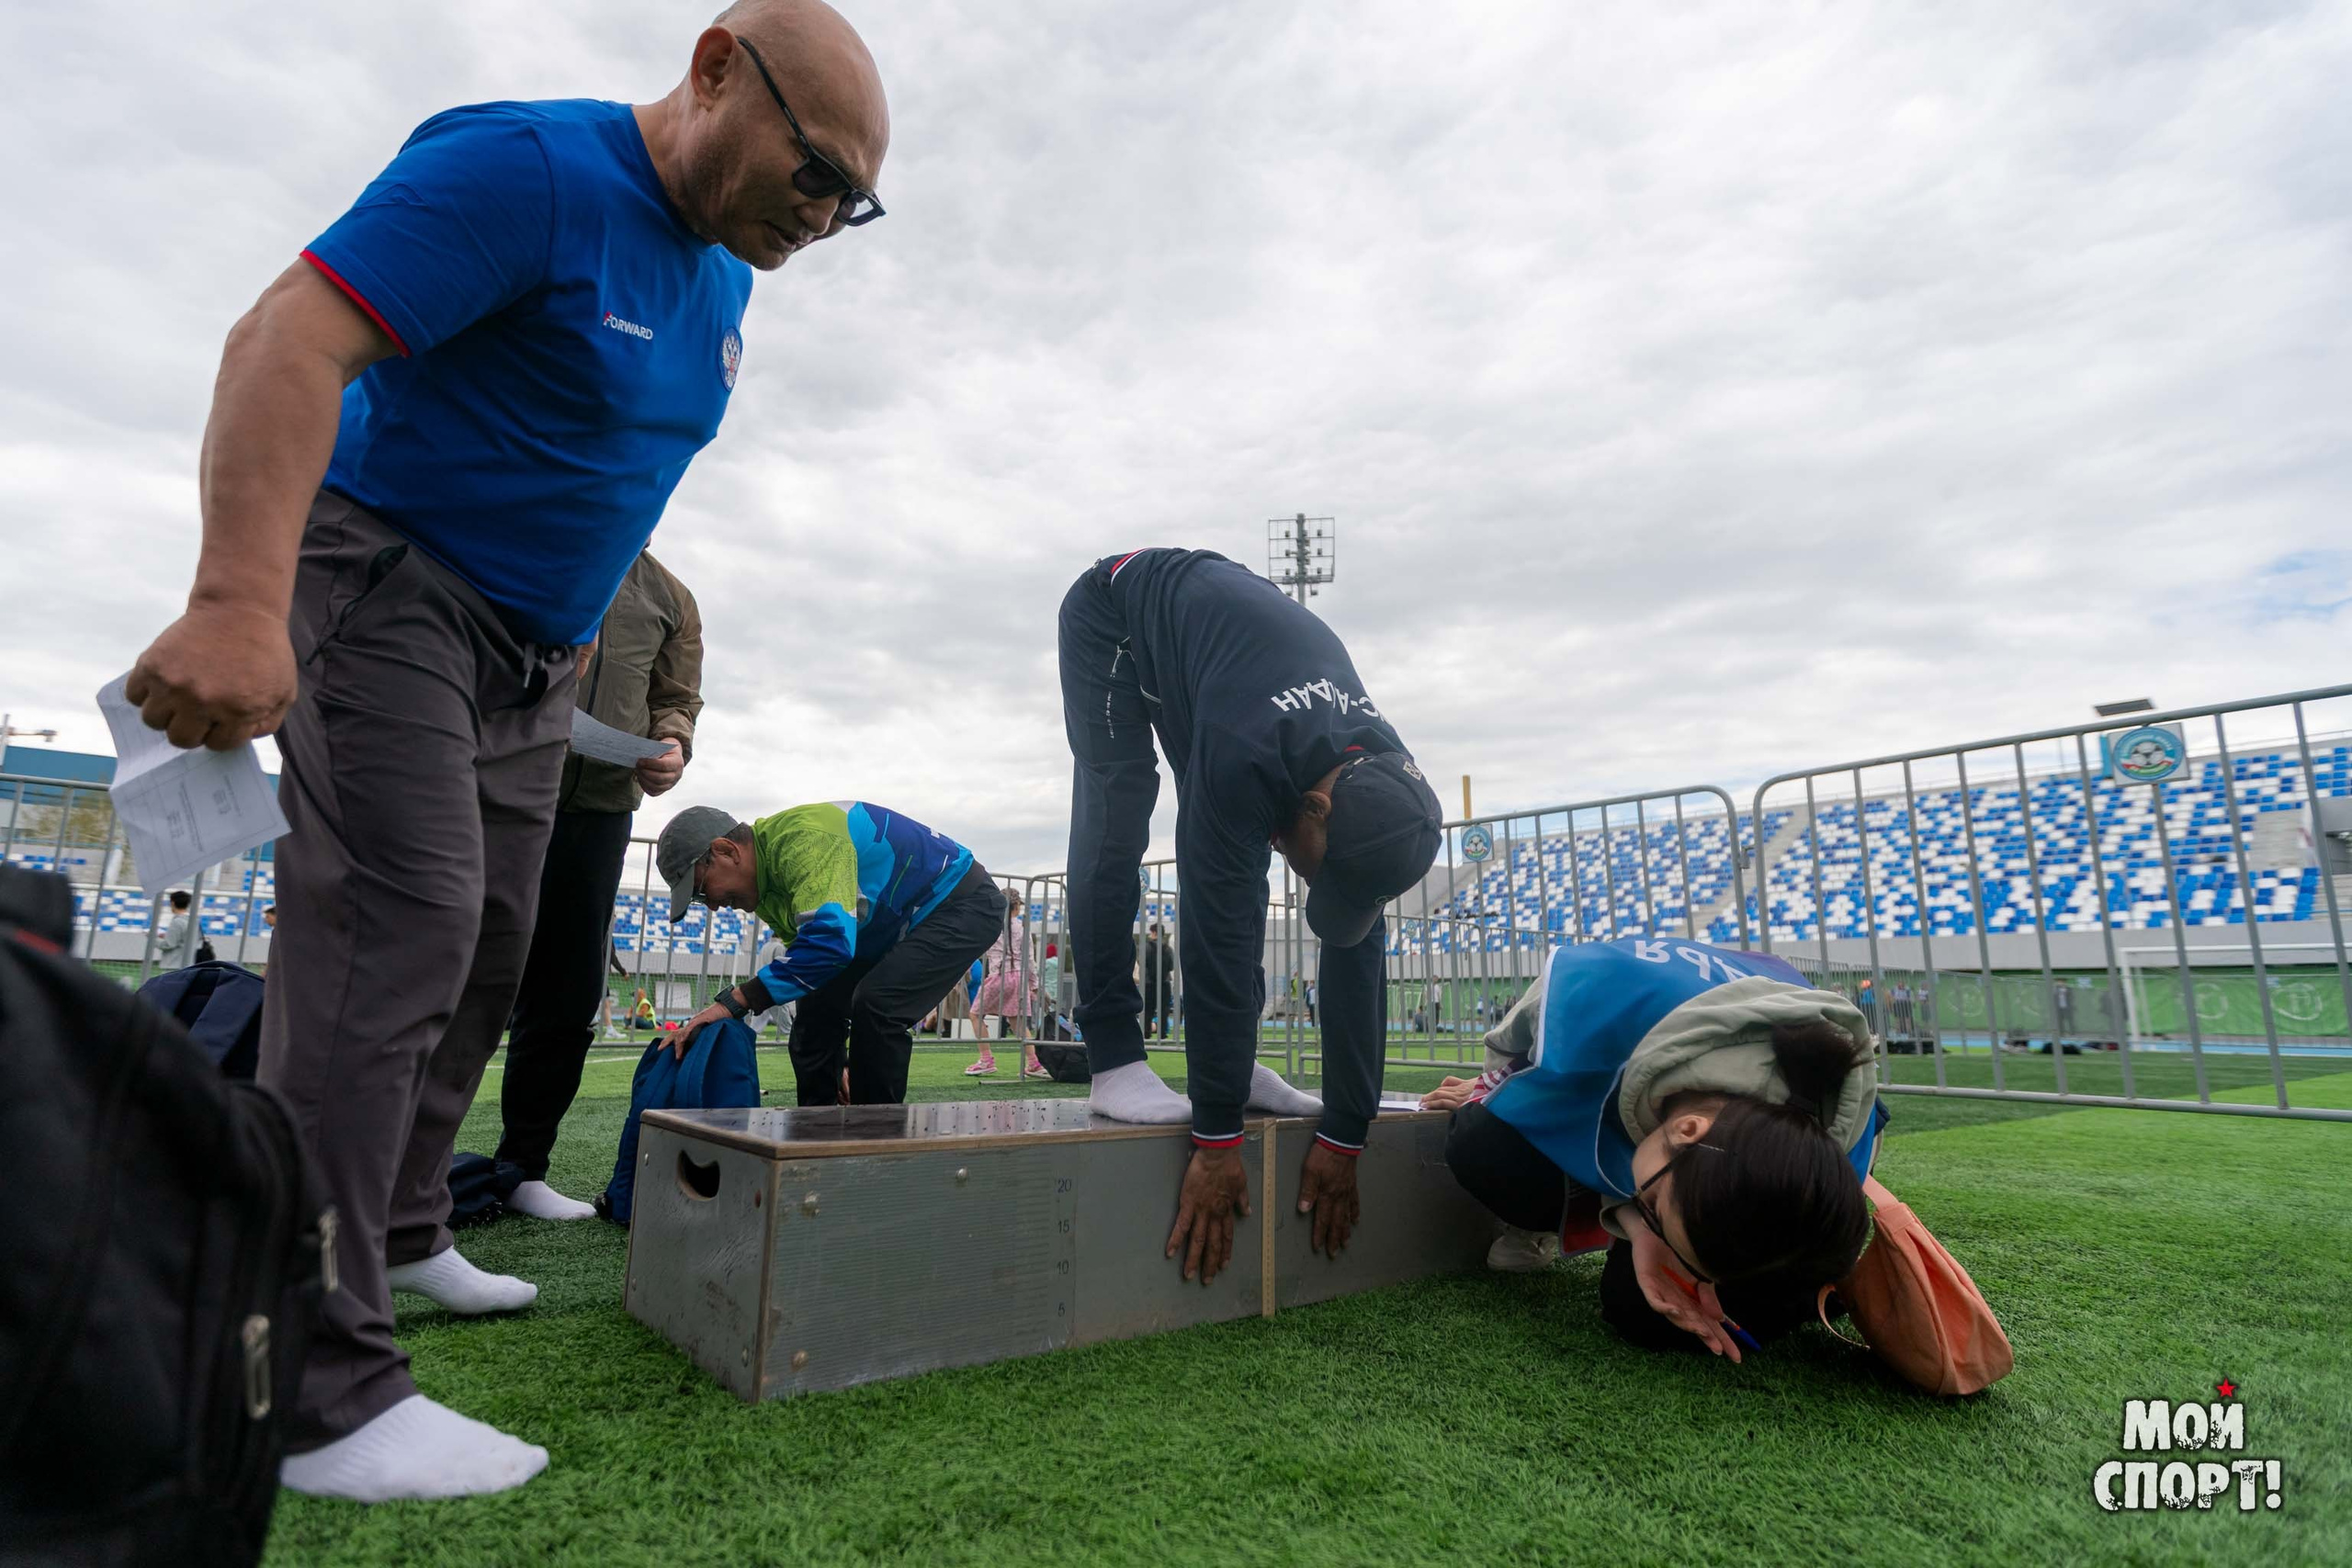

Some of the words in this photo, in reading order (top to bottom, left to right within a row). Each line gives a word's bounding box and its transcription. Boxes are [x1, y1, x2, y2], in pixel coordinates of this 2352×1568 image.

[604, 310, 653, 340] FORWARD
[1057, 1179, 1072, 1193] 20
[1057, 1219, 1070, 1234] 15
[1057, 1260, 1069, 1275] 10
[1057, 1303, 1066, 1317] 5
